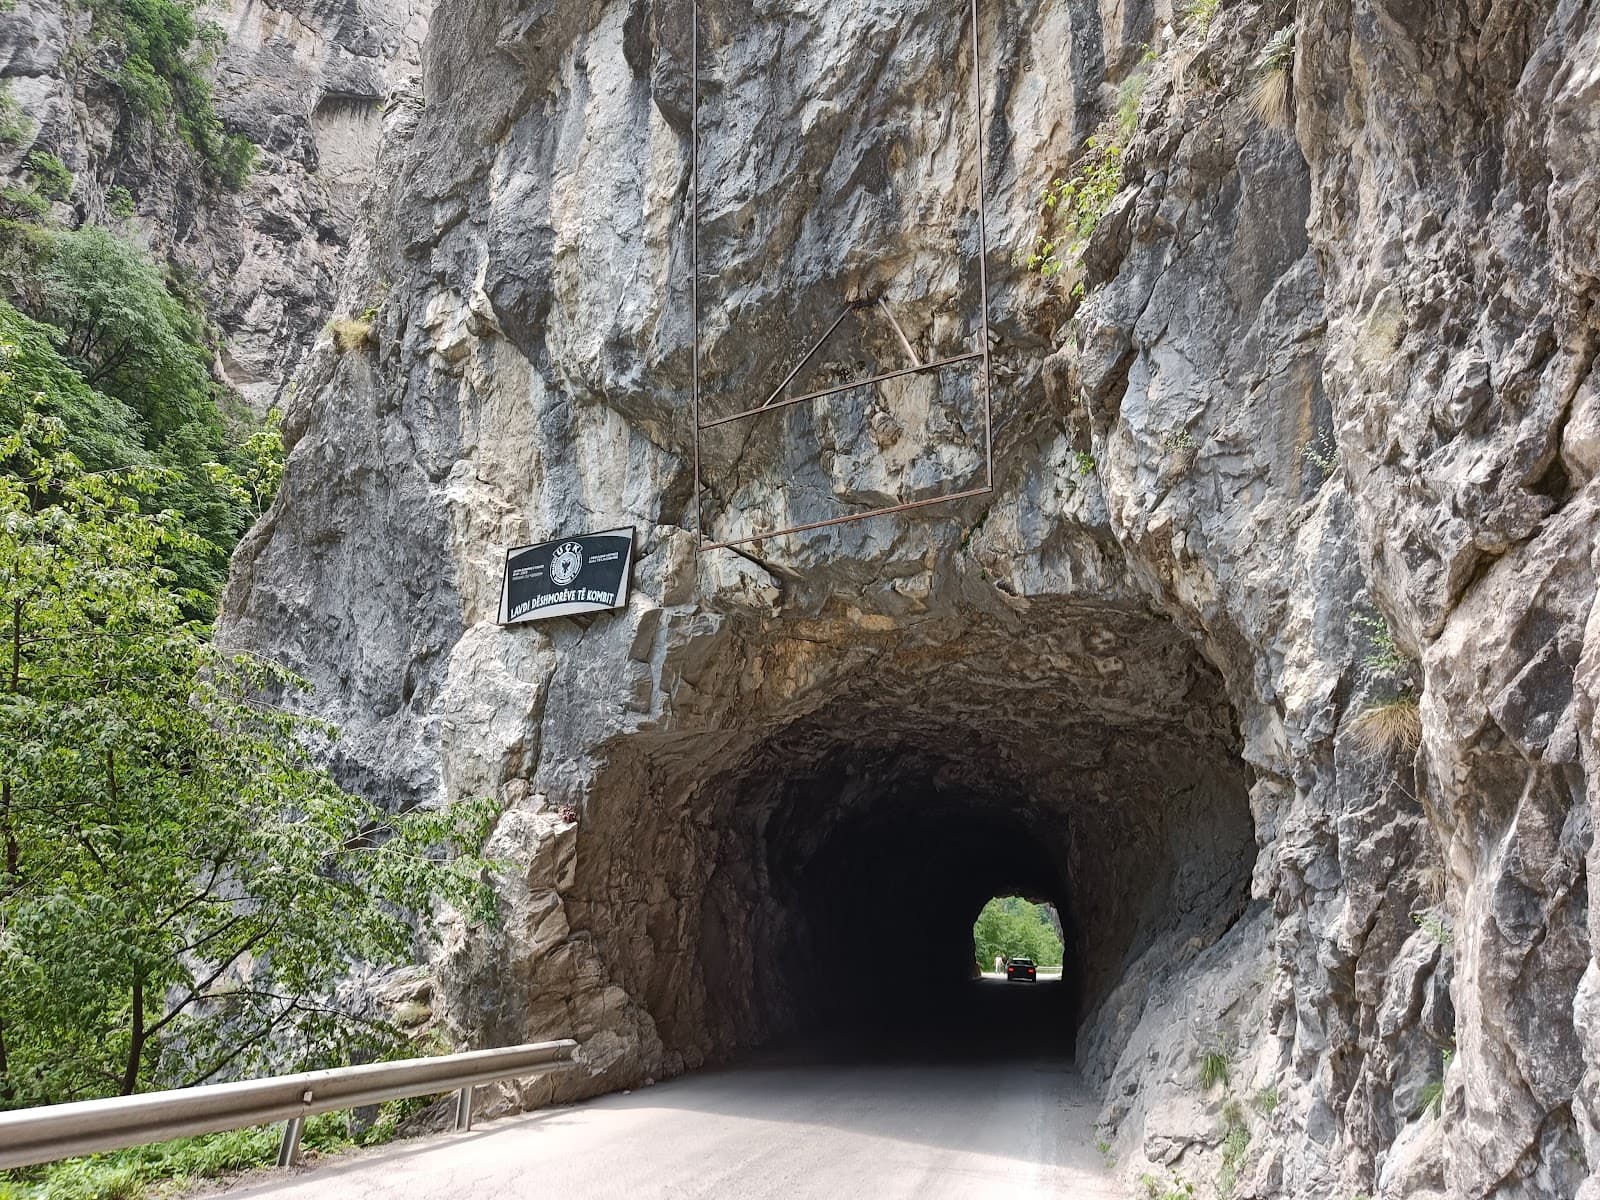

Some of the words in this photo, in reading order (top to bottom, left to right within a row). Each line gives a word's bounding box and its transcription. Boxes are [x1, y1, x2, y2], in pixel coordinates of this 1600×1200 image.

[510, 601, 530, 619] LAVDI
[531, 588, 576, 609] DËSHMORËVE
[577, 587, 587, 601] TË
[586, 590, 615, 604] KOMBIT
